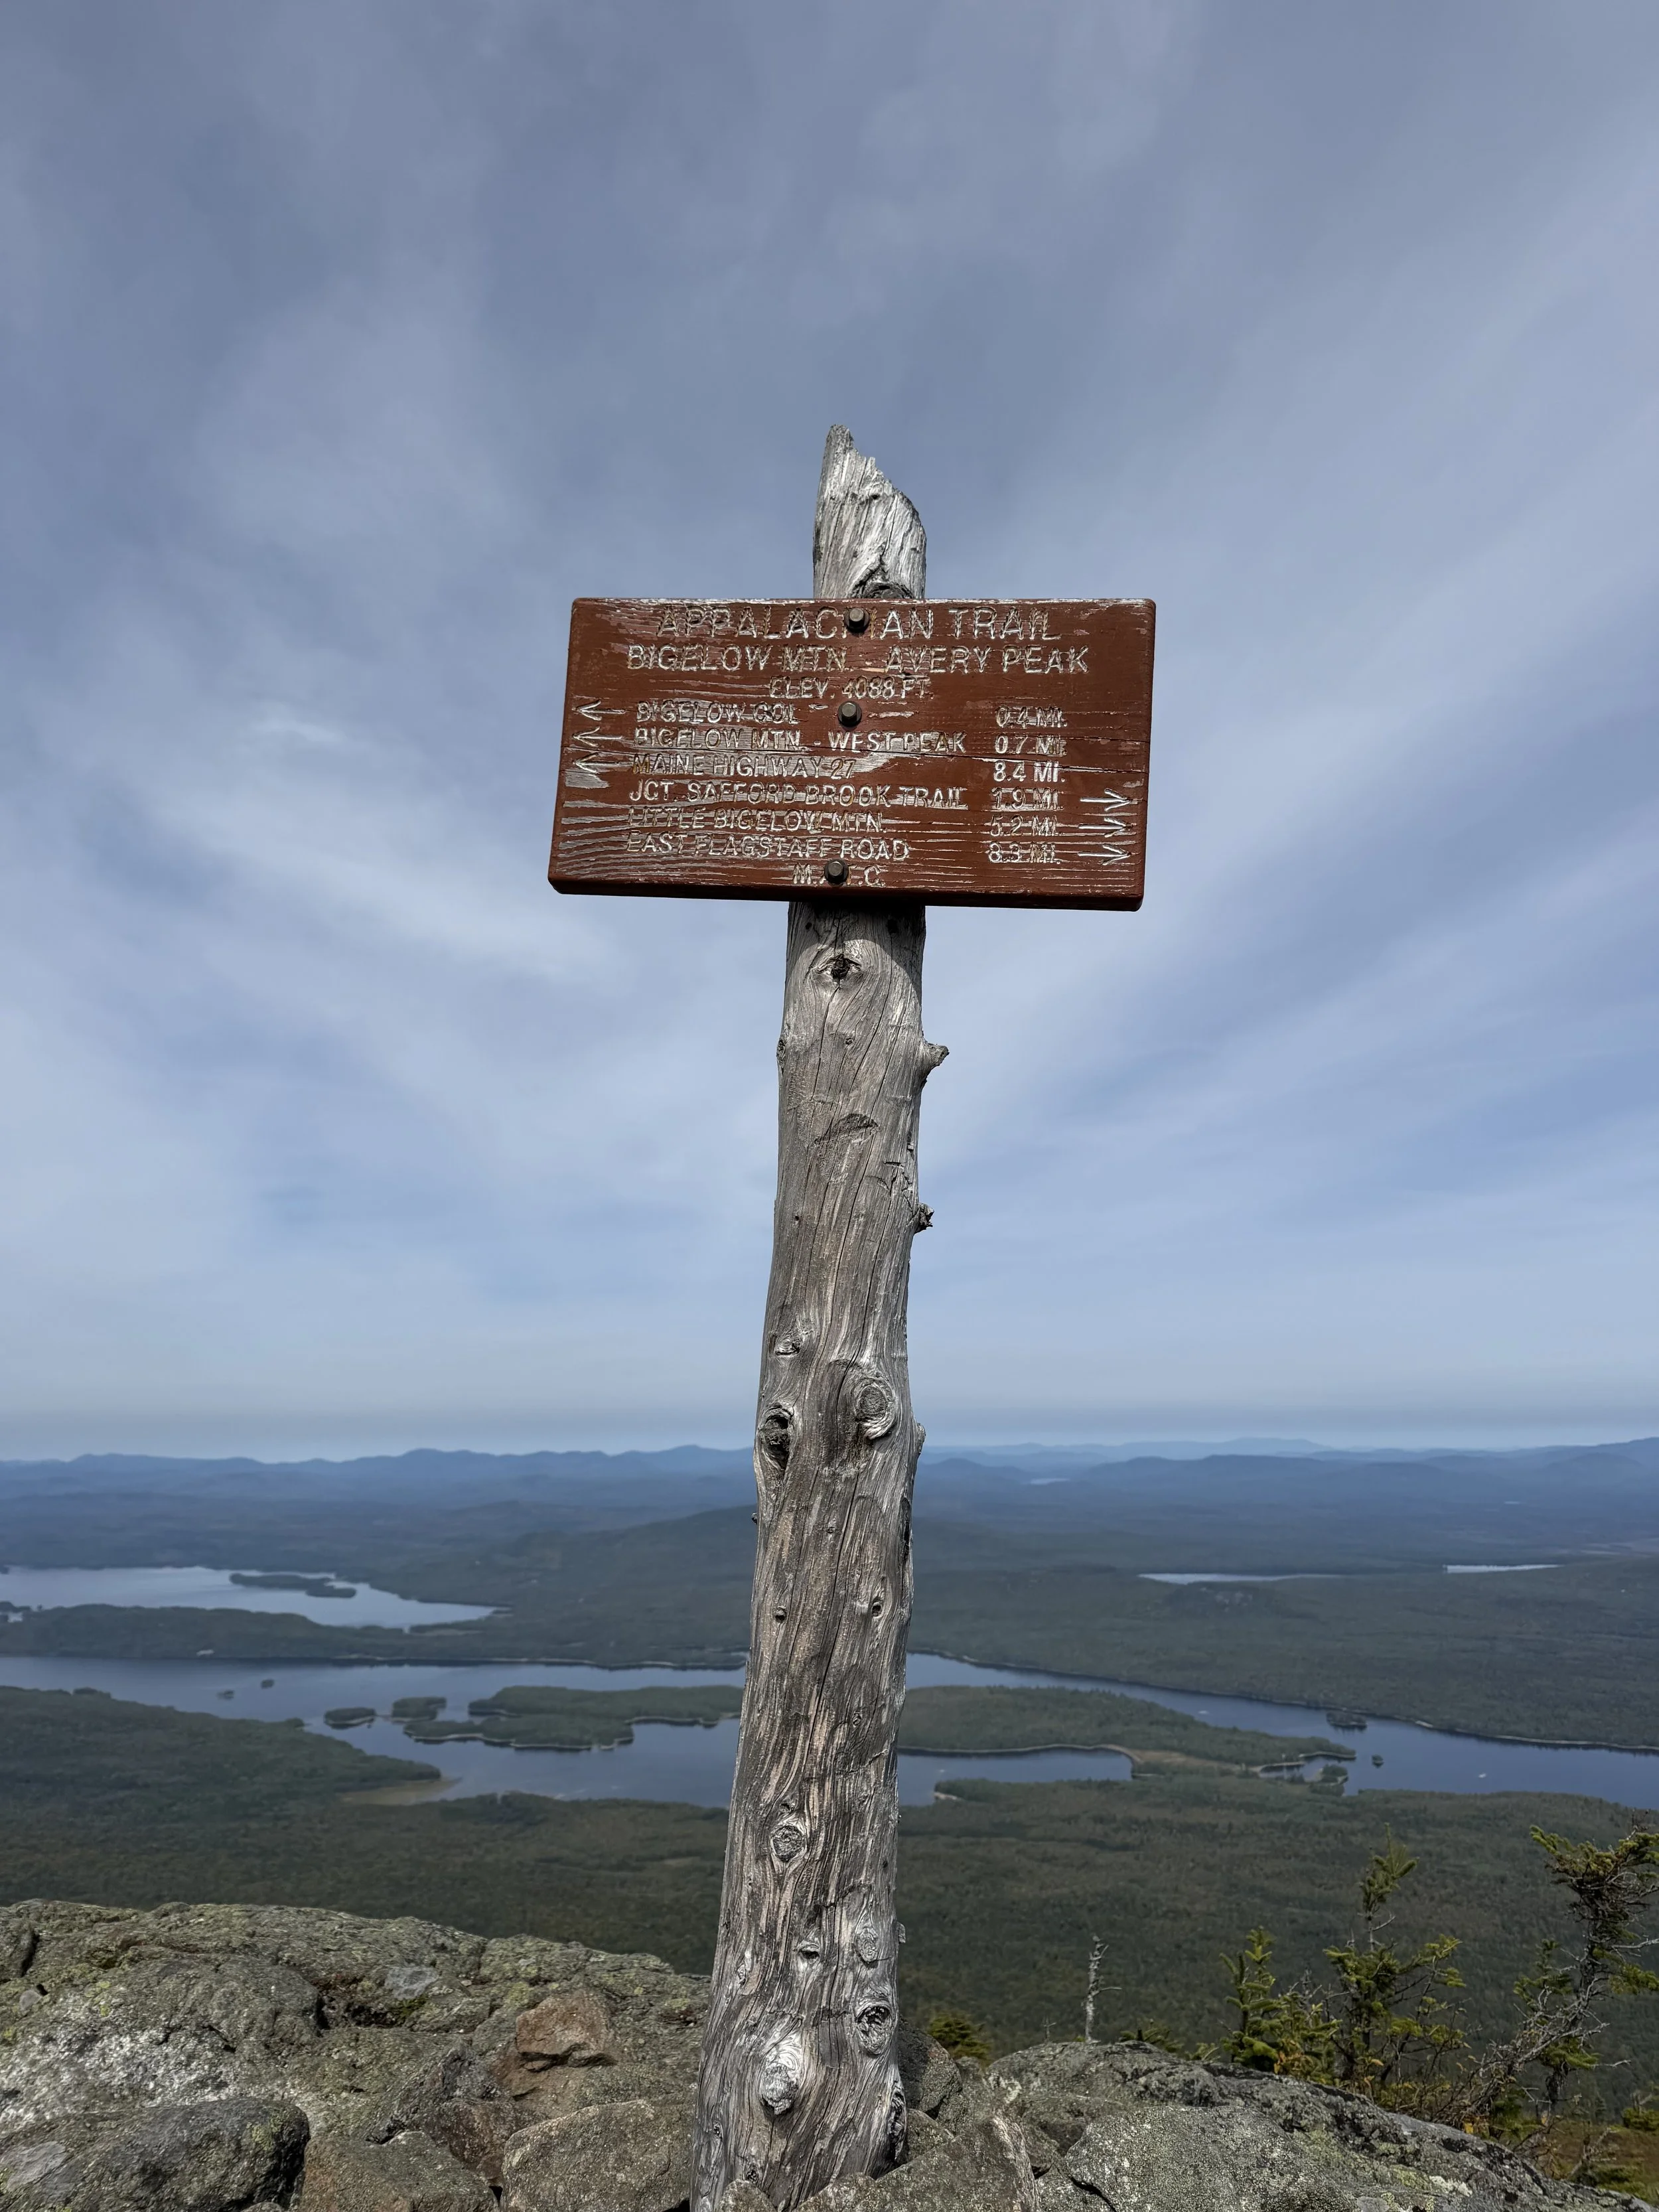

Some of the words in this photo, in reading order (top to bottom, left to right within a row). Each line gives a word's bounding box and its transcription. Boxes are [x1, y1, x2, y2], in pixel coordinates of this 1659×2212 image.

[657, 605, 934, 639] APPALACIAN
[949, 607, 1061, 640] TRAIL
[628, 643, 772, 672] BIGELOW
[885, 644, 991, 674] AVERY
[1003, 645, 1090, 674] PEAK
[769, 676, 835, 699] ELEV.
[841, 676, 895, 700] 4088
[636, 700, 746, 723] BIGELOW
[1035, 706, 1068, 728] MI.
[634, 726, 743, 749] BIGELOW
[828, 729, 895, 753] WEST
[903, 731, 967, 754] PEAK
[632, 753, 705, 776] MAINE
[713, 755, 825, 778] HIGHWAY
[830, 758, 857, 780] 27
[993, 761, 1027, 782] 8.4
[1034, 760, 1066, 782] MI.
[687, 780, 797, 804] SAFFORD
[805, 783, 892, 808] BROOK
[899, 786, 969, 809] TRAIL
[628, 806, 706, 829] LITTLE
[714, 808, 823, 832] BIGELOW
[626, 830, 688, 854] EAST
[694, 834, 831, 857] FLAGSTAFF
[839, 838, 910, 861] ROAD
